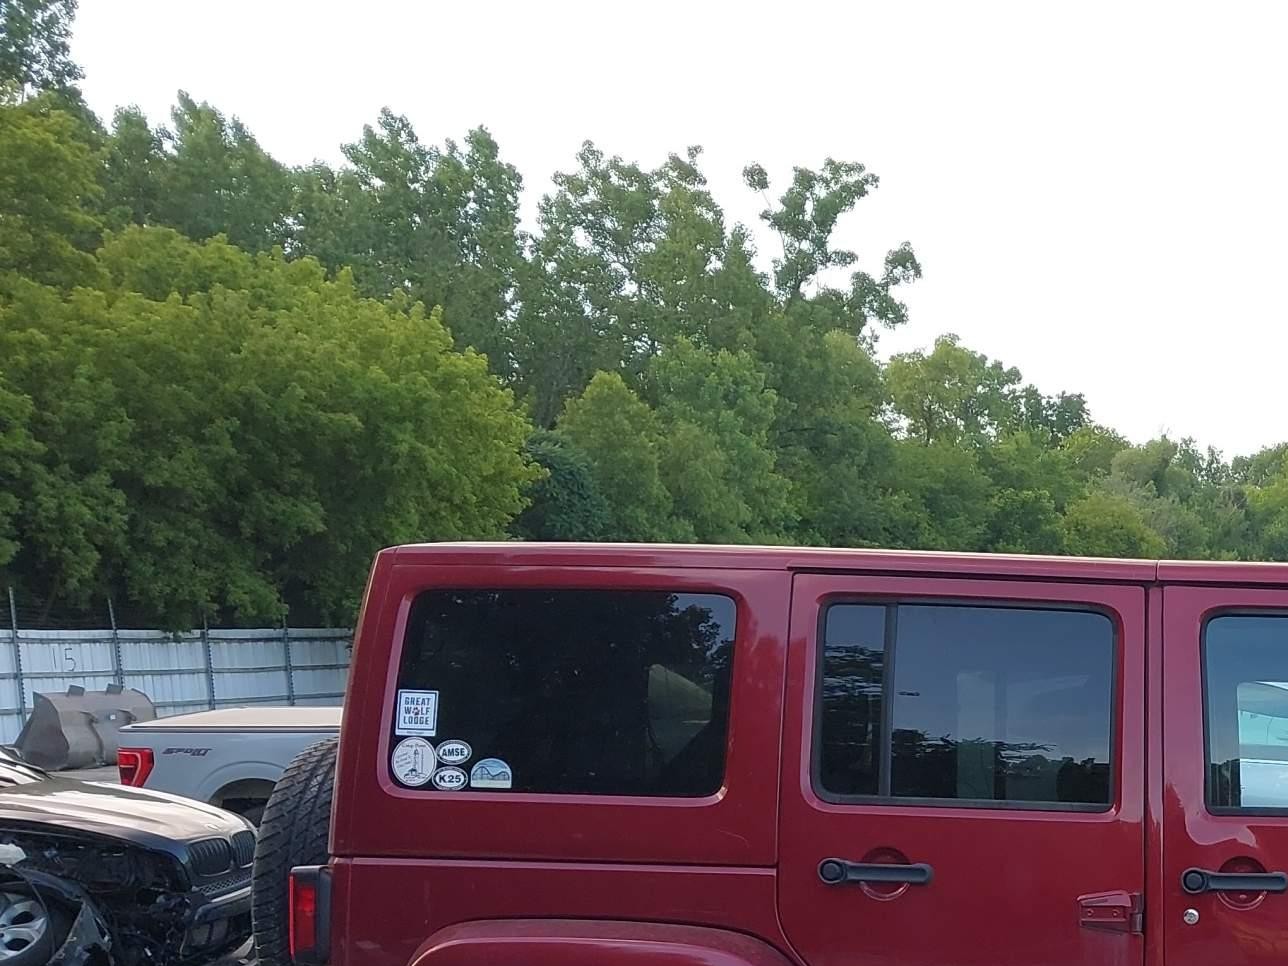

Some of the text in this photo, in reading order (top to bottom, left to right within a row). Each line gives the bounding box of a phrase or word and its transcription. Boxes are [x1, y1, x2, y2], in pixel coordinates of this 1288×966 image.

[52, 647, 77, 671] 15
[404, 696, 432, 706] GREAT
[403, 715, 430, 725] LODGE
[441, 747, 466, 757] AMSE
[438, 774, 462, 783] K25
